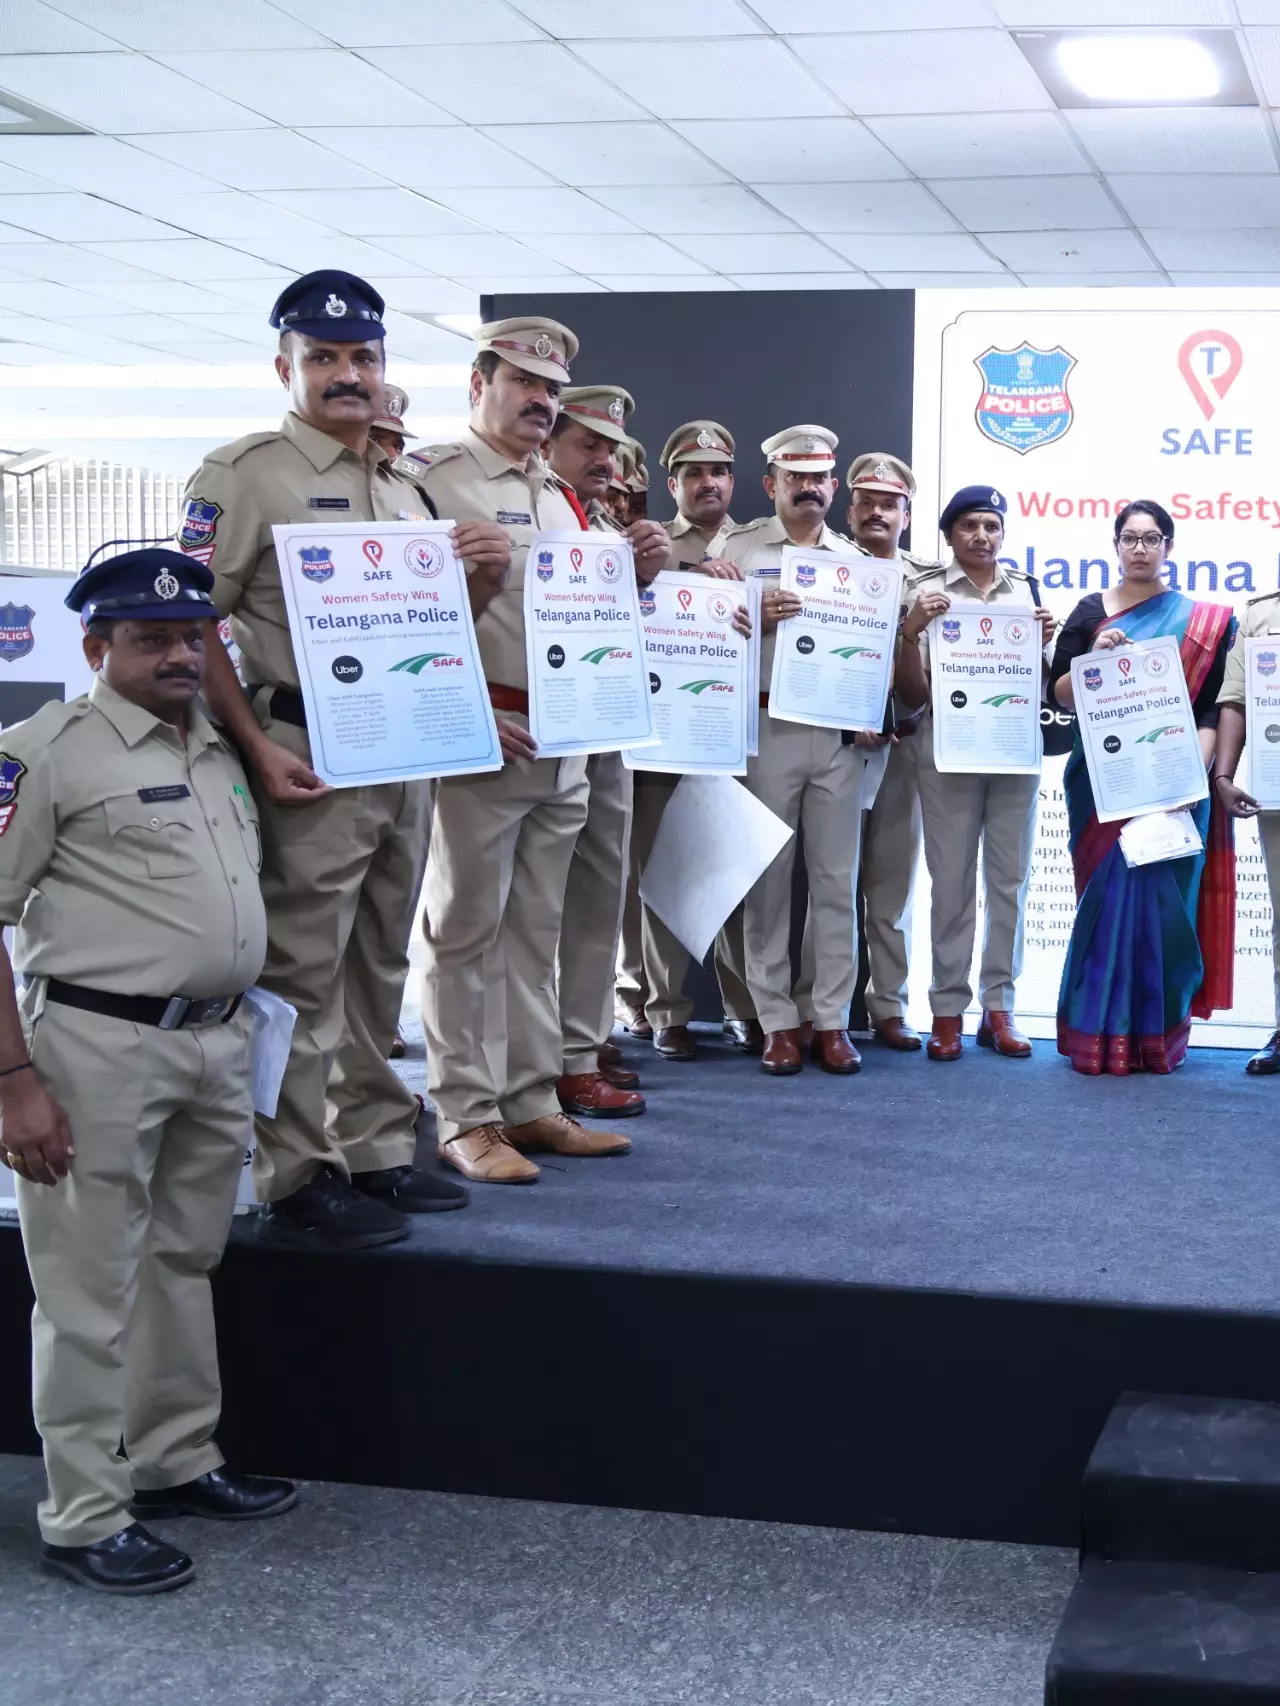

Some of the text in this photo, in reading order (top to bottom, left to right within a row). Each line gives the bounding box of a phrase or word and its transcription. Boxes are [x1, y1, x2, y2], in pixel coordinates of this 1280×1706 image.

[1200, 346, 1221, 375] T
[988, 384, 1061, 396] TELANGANA
[983, 395, 1066, 414] POLICE
[1160, 428, 1253, 456] SAFE
[364, 570, 392, 581] SAFE
[569, 576, 587, 584] SAFE
[832, 586, 851, 596] SAFE
[322, 590, 440, 604] Women Safety Wing
[544, 592, 617, 604] Women Safety Wing
[804, 595, 878, 614] Women Safety Wing
[305, 609, 458, 630] Telangana Police
[534, 608, 630, 624] Telangana Police
[676, 612, 696, 621] SAFE
[798, 608, 888, 630] elangana Police
[0, 631, 30, 640] OLICE
[644, 625, 676, 636] Women
[678, 628, 704, 640] Safety
[706, 631, 726, 642] Wing
[798, 641, 813, 649] Uber
[976, 638, 994, 646] SAFE
[646, 640, 738, 658] langana Police
[549, 652, 564, 660] Uber
[608, 651, 632, 659] SAFE
[860, 651, 882, 660] SAFE
[979, 652, 1002, 660] Safety
[1003, 653, 1022, 662] Wing
[432, 658, 464, 668] SAFE
[335, 665, 359, 674] Uber
[940, 662, 1032, 676] Telangana Police
[1118, 676, 1136, 686] SAFE
[711, 684, 734, 692] SAFE
[1096, 685, 1168, 704] Women Safety Wing
[1088, 694, 1181, 722] Telangana Police
[1164, 726, 1185, 736] SAFE
[1106, 740, 1119, 748] Uber
[1034, 848, 1066, 860] app.
[1028, 882, 1074, 893] cation
